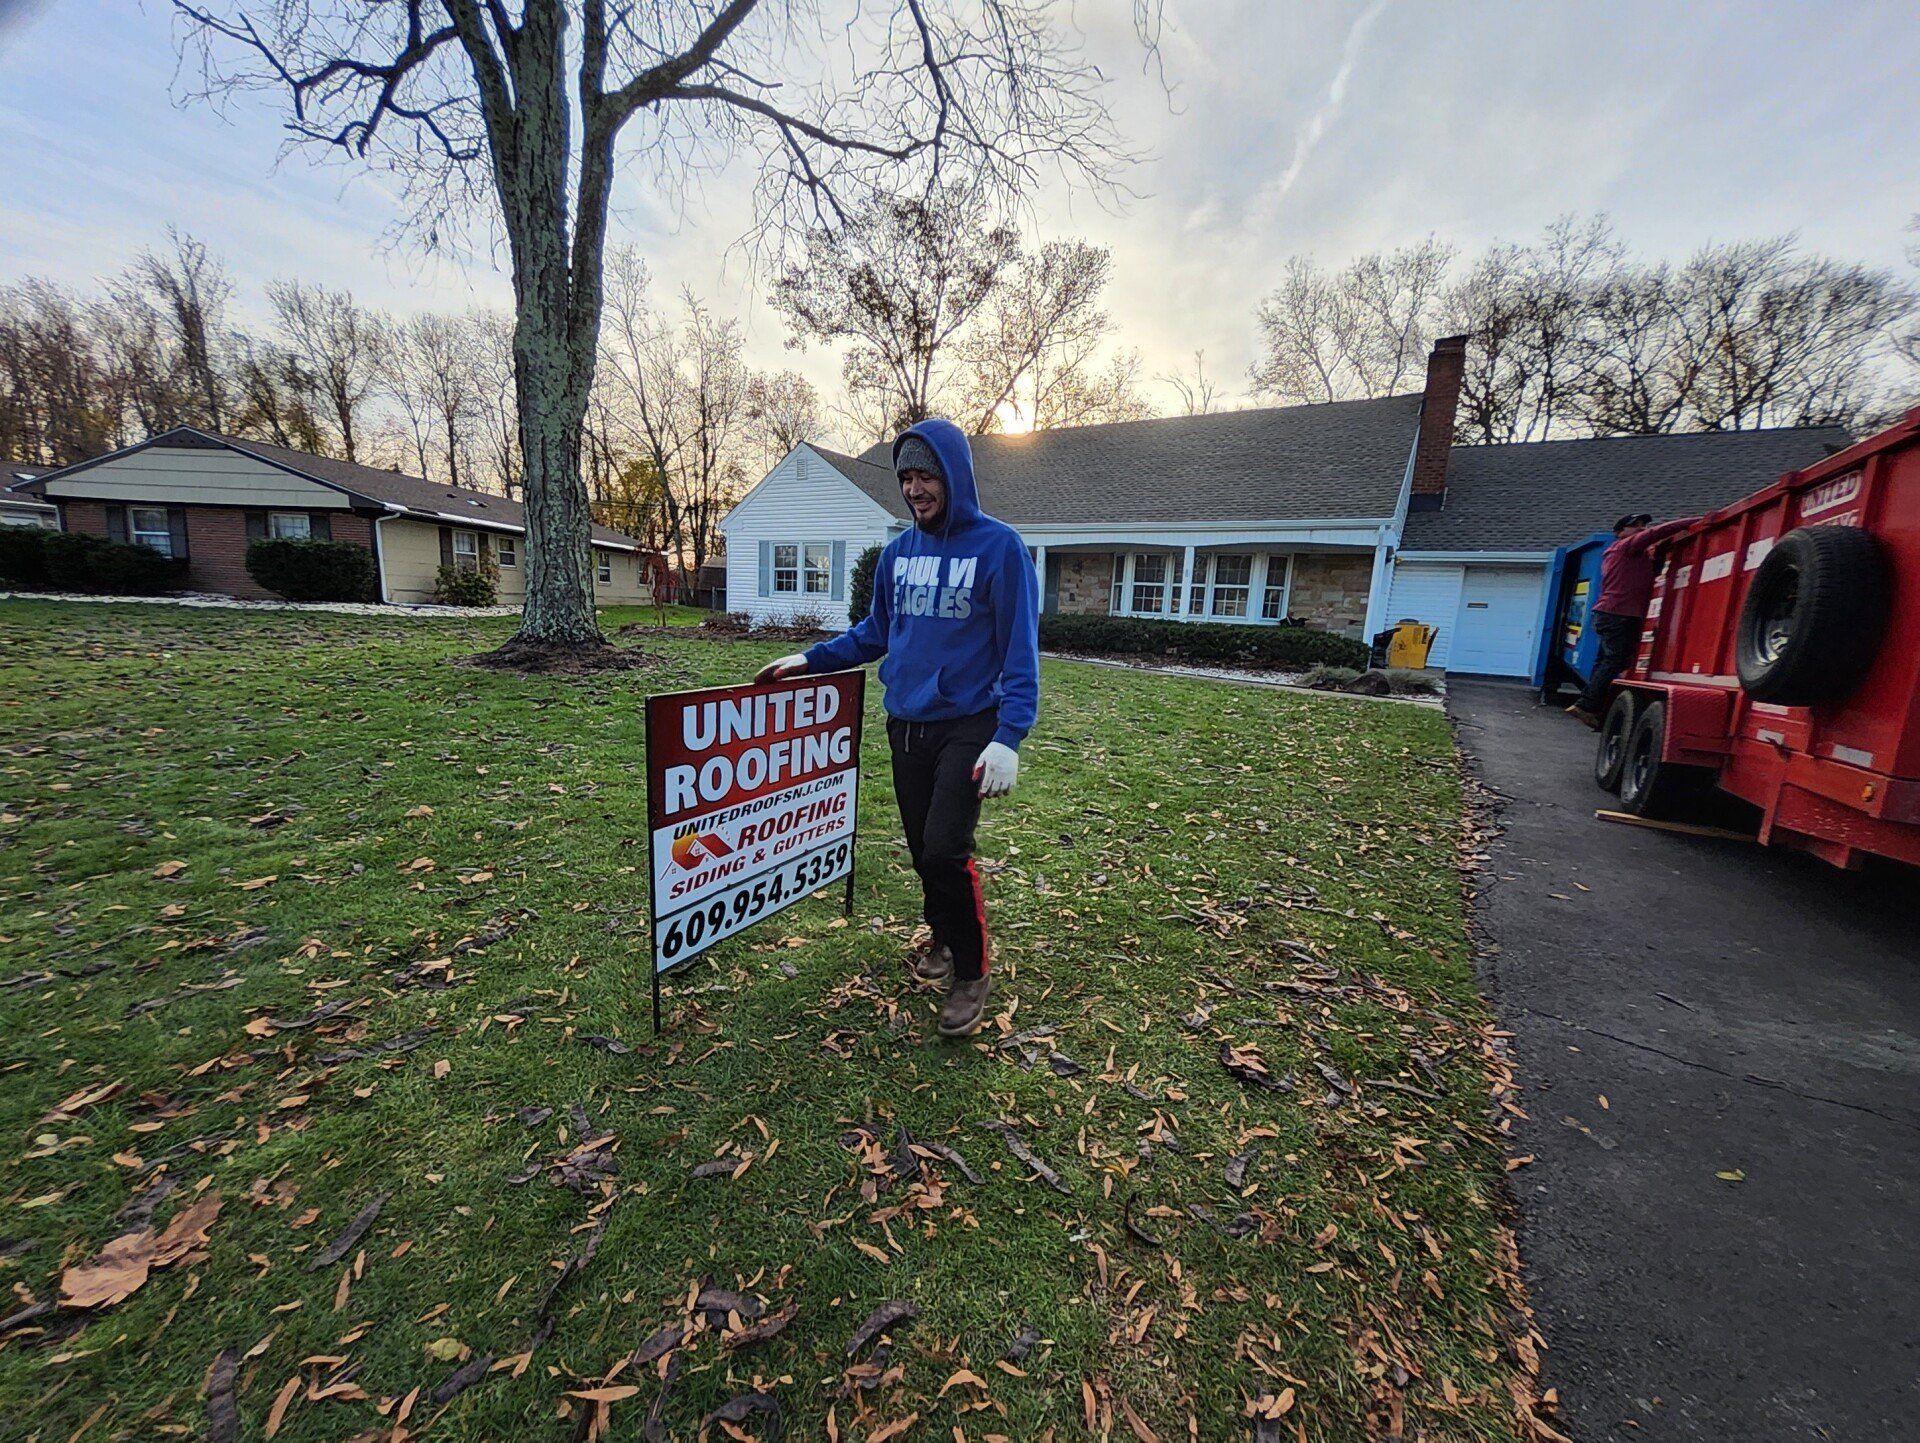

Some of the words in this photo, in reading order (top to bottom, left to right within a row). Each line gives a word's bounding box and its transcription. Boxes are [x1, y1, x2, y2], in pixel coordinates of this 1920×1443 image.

[894, 556, 941, 586] PAUL
[948, 556, 978, 588] VI
[682, 684, 840, 752] UNITED
[664, 726, 851, 815] ROOFING
[673, 774, 844, 841] UNITEDROOFSNJ.COM
[736, 792, 847, 851] ROOFING
[668, 854, 746, 900] SIDING
[752, 849, 766, 865] &
[772, 816, 846, 856] GUTTERS
[662, 843, 848, 959] 609.954.5359
